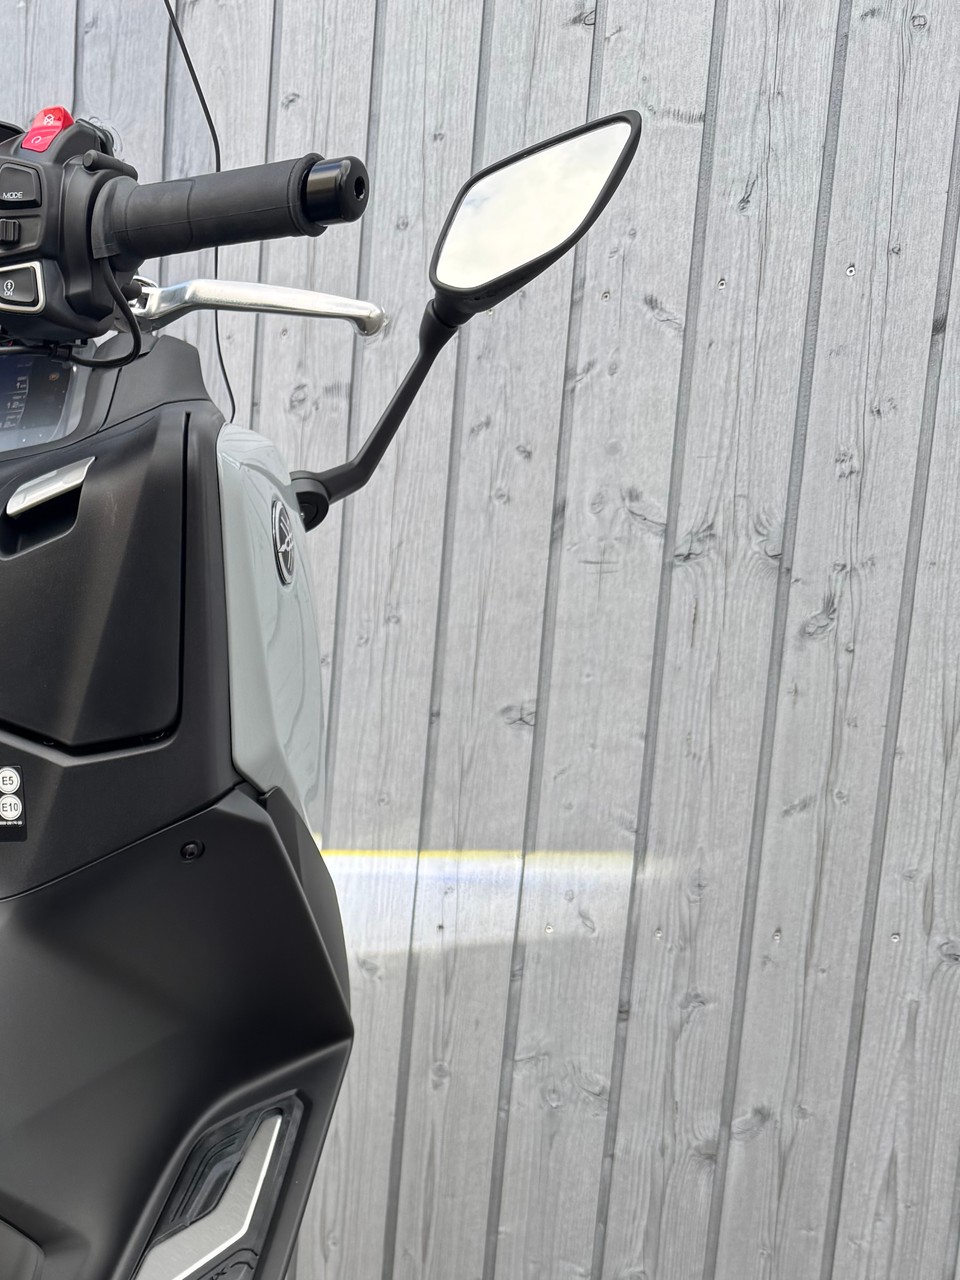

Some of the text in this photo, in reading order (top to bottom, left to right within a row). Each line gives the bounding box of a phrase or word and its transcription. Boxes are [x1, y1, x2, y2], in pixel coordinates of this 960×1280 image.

[2, 191, 24, 199] MODE
[1, 776, 14, 786] E5
[1, 802, 19, 812] E10
